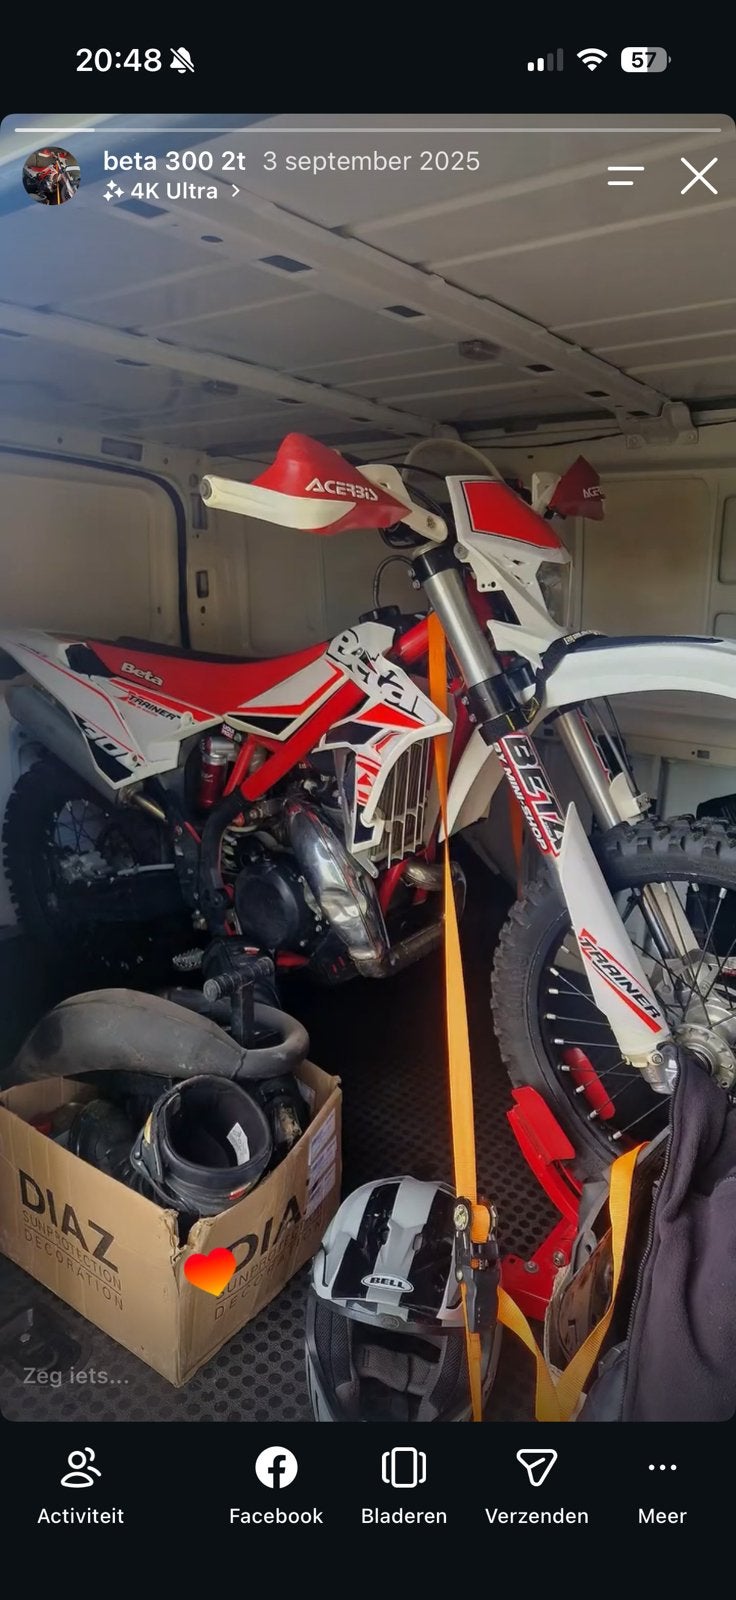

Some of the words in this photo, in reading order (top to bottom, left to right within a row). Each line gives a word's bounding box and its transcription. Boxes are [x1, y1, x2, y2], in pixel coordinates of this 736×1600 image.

[121, 662, 163, 686] Beta
[128, 694, 178, 720] TRAINER
[503, 767, 548, 850] MINI-SHOP
[580, 937, 662, 1019] TRAINER
[19, 1168, 119, 1273] DIAZ
[22, 1209, 122, 1291] SUNPROTECTION
[24, 1228, 123, 1311] DECORATION
[370, 1276, 405, 1290] BELL
